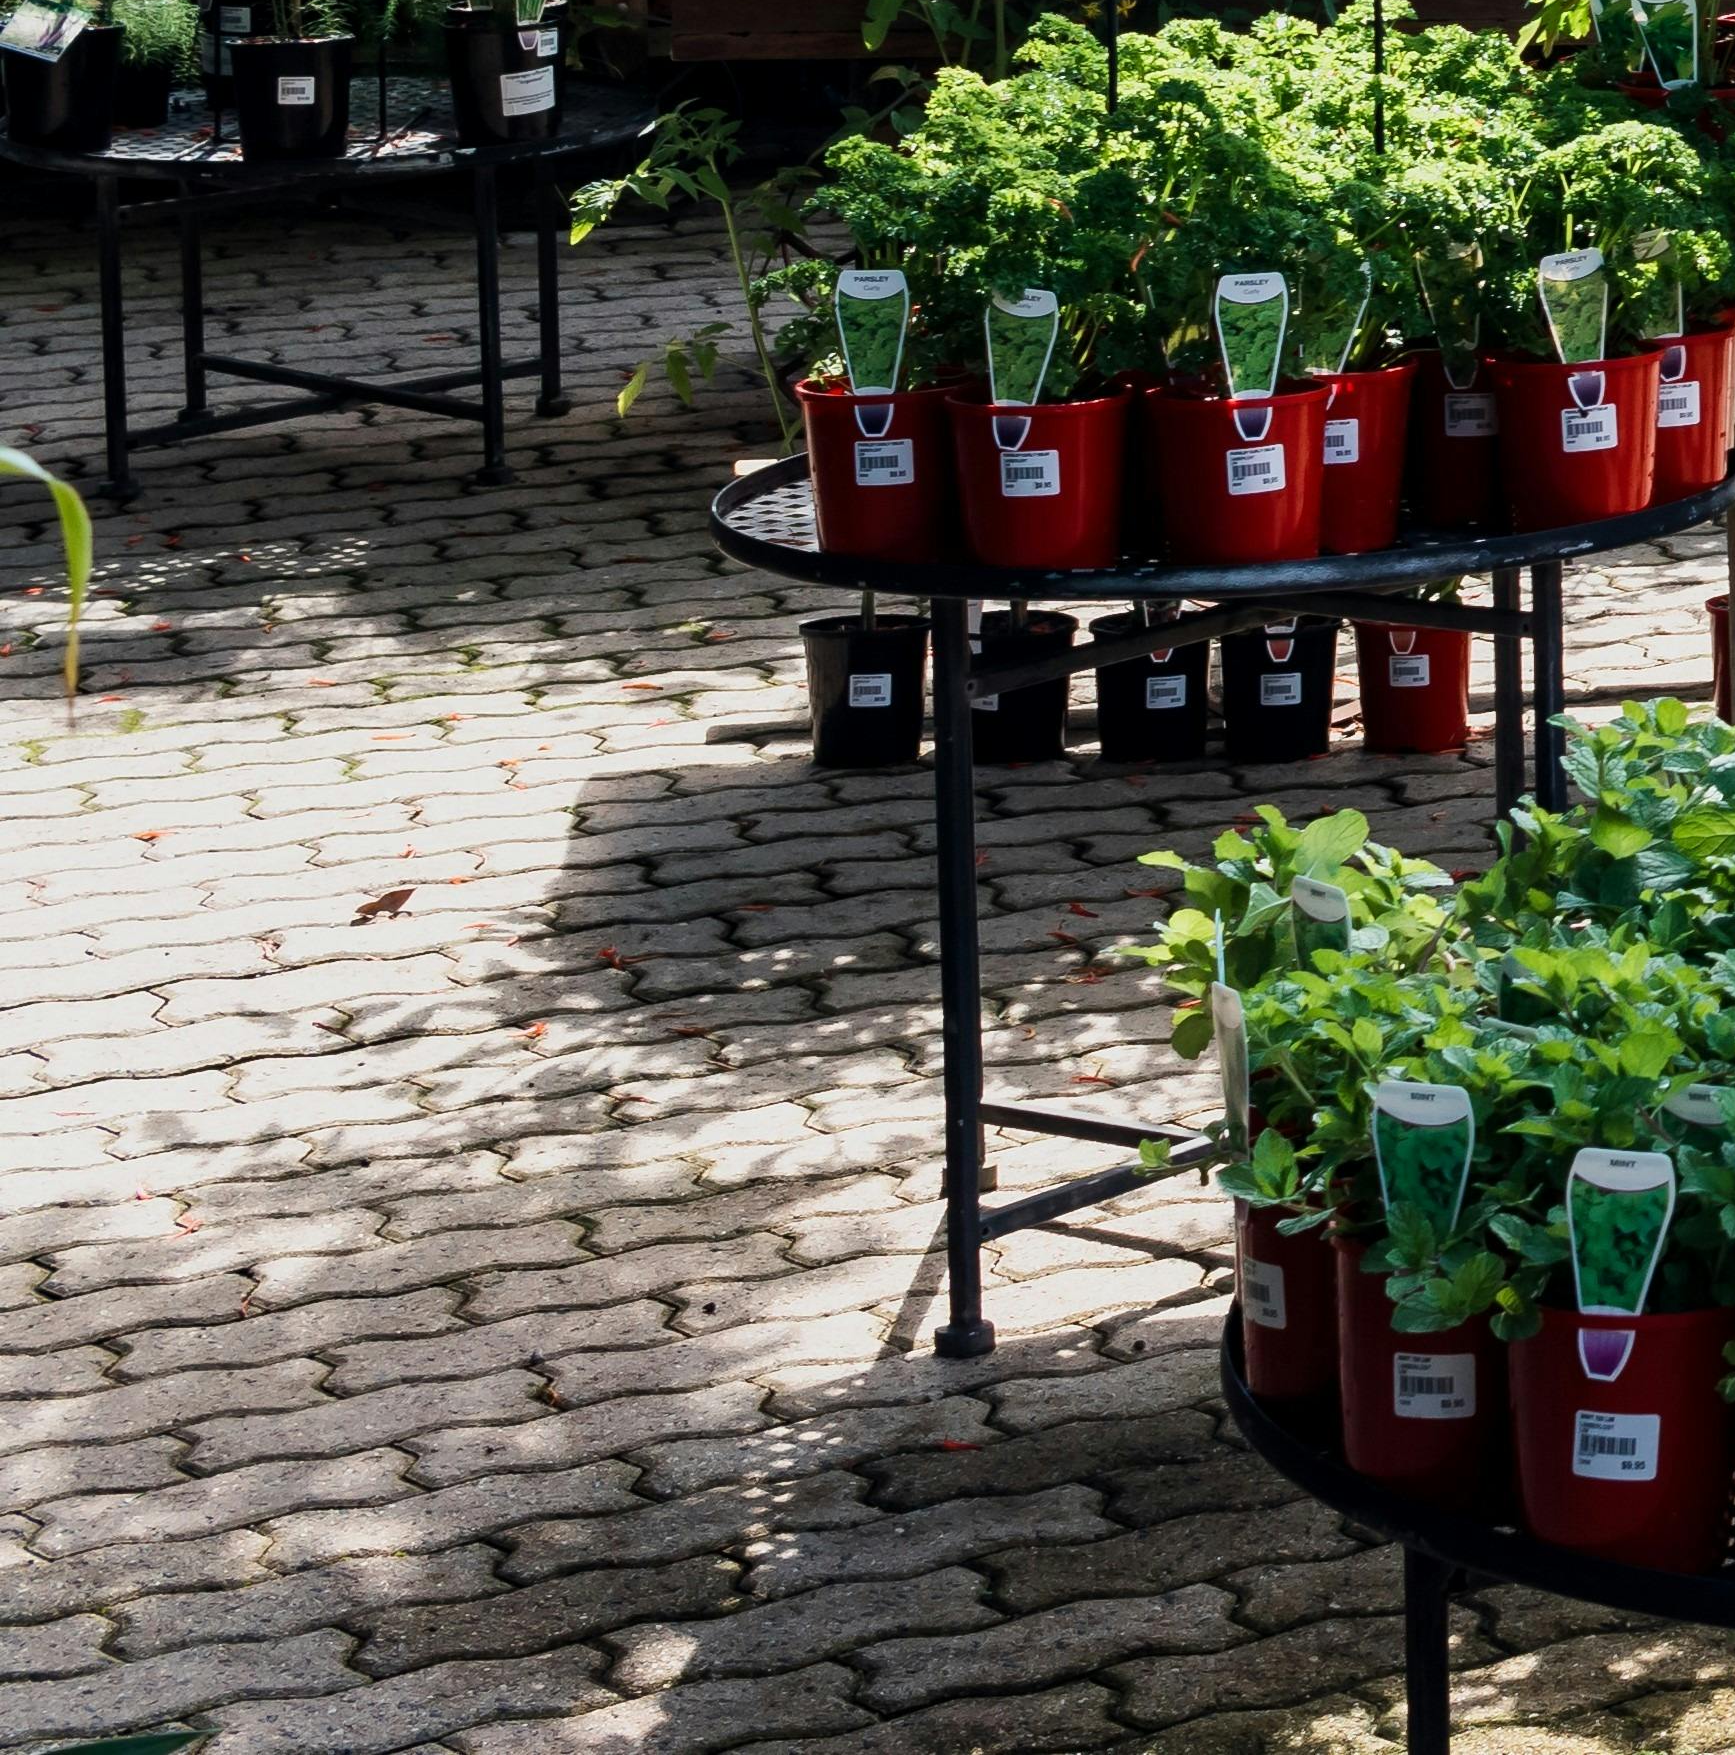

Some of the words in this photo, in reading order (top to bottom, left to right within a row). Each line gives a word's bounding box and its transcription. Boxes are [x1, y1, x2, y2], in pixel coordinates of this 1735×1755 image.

[1555, 253, 1588, 267] PARSLEY
[1234, 278, 1269, 287] PARSLEY
[1410, 1092, 1435, 1100] MINT
[1609, 1159, 1636, 1167] MINT
[1621, 1461, 1645, 1469] $9.95
